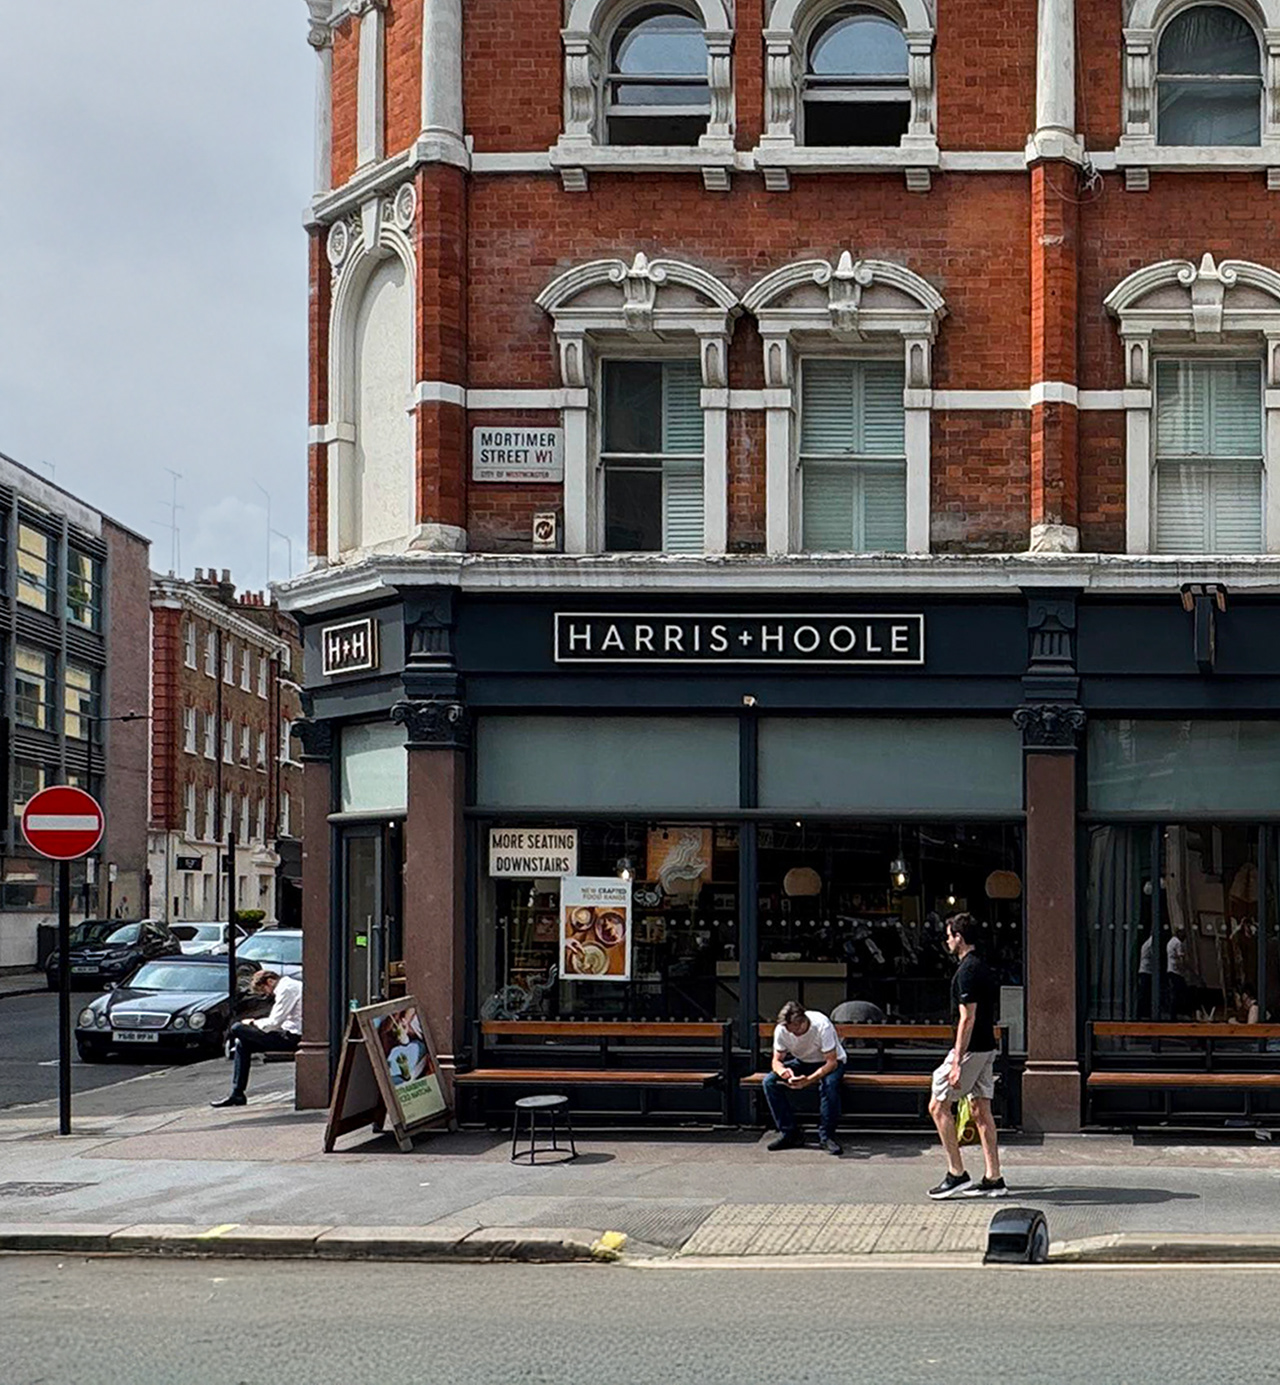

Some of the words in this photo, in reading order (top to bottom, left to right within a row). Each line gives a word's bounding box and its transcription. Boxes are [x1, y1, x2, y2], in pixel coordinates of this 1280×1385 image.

[480, 432, 556, 447] MORTIMER
[480, 449, 530, 463] STREET
[535, 450, 553, 463] W1
[329, 631, 365, 663] H+H
[492, 834, 523, 849] MORE
[527, 834, 574, 850] SEATING
[496, 856, 570, 872] DOWNSTAIRS
